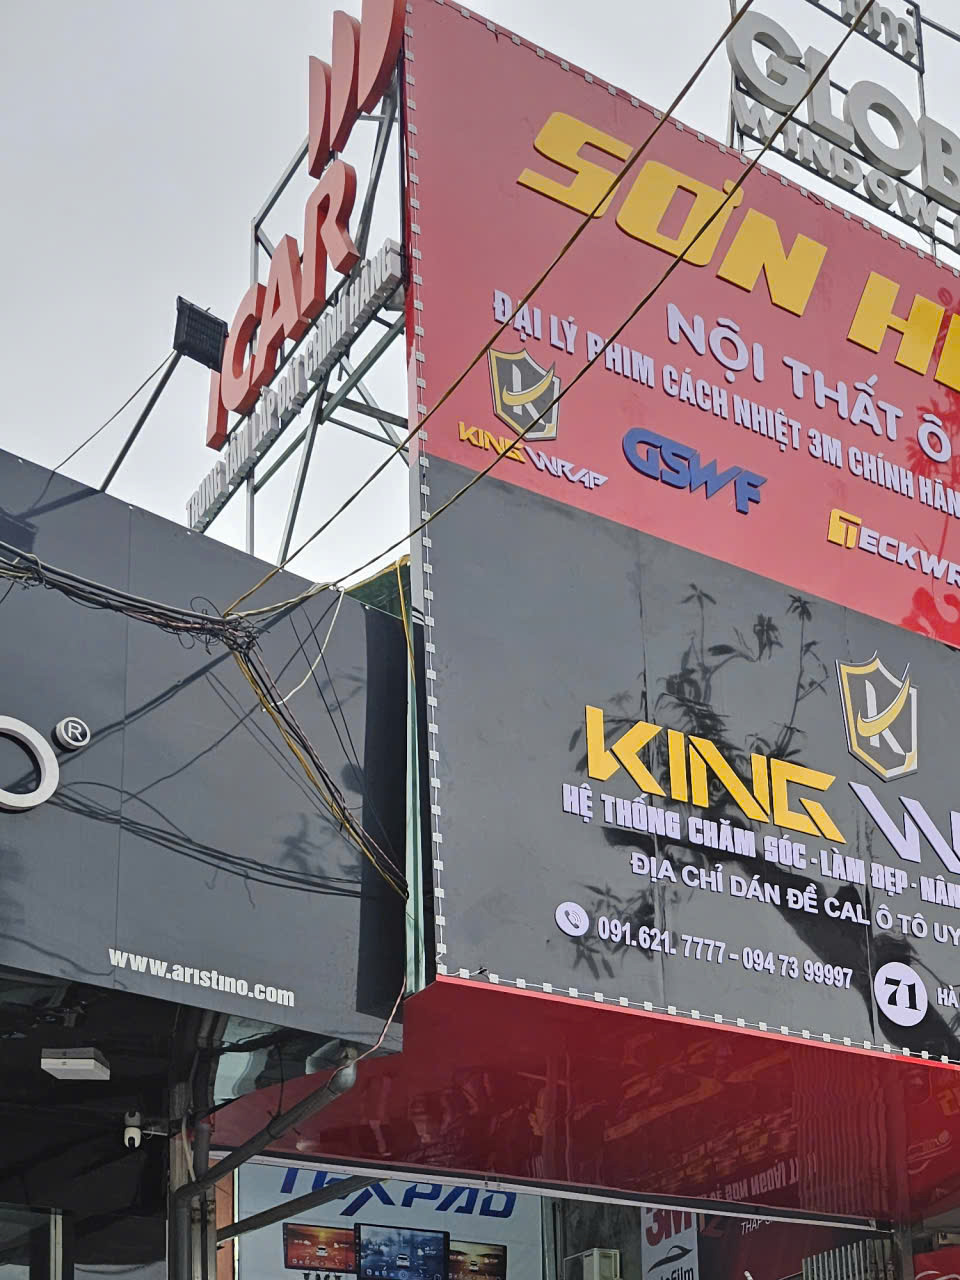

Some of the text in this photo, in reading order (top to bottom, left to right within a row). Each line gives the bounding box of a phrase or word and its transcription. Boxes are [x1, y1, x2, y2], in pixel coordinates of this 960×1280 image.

[516, 111, 828, 317] SƠN
[730, 89, 938, 240] WINDOW
[205, 160, 360, 451] ICAR
[186, 460, 231, 532] TRUNG
[224, 415, 257, 486] TÂM
[304, 288, 352, 382] CHÍNH
[492, 289, 542, 341] ĐẠI
[549, 314, 578, 354] LÝ
[586, 330, 655, 389] PHIM
[662, 364, 729, 420] CÁCH
[733, 393, 801, 451] NHIỆT
[807, 428, 843, 469] 3M
[848, 445, 914, 500] CHÍNH
[666, 302, 765, 384] NỘI
[783, 355, 903, 442] THẤT
[917, 413, 952, 464] Ô
[458, 420, 609, 489] KING WRAP
[621, 426, 768, 515] GSWF
[585, 704, 847, 845] KING
[562, 782, 594, 823] HỆ
[600, 792, 682, 840] THỐNG
[687, 818, 757, 859] CHĂM
[763, 834, 807, 869] SÓC
[818, 847, 866, 886] LÀM
[870, 861, 908, 896] ĐẸP
[630, 851, 678, 884] ĐỊA
[681, 863, 724, 894] CHỈ
[730, 873, 782, 907] DÁN
[786, 881, 820, 915] ĐỀ
[823, 895, 871, 927] CAL
[875, 903, 893, 931] Ô
[897, 911, 929, 939] TÔ
[681, 933, 727, 965] 7777
[742, 946, 776, 975] 094
[777, 954, 800, 980] 73
[802, 961, 854, 990] 99997
[883, 977, 922, 1012] 71
[936, 984, 959, 1009] HÀ
